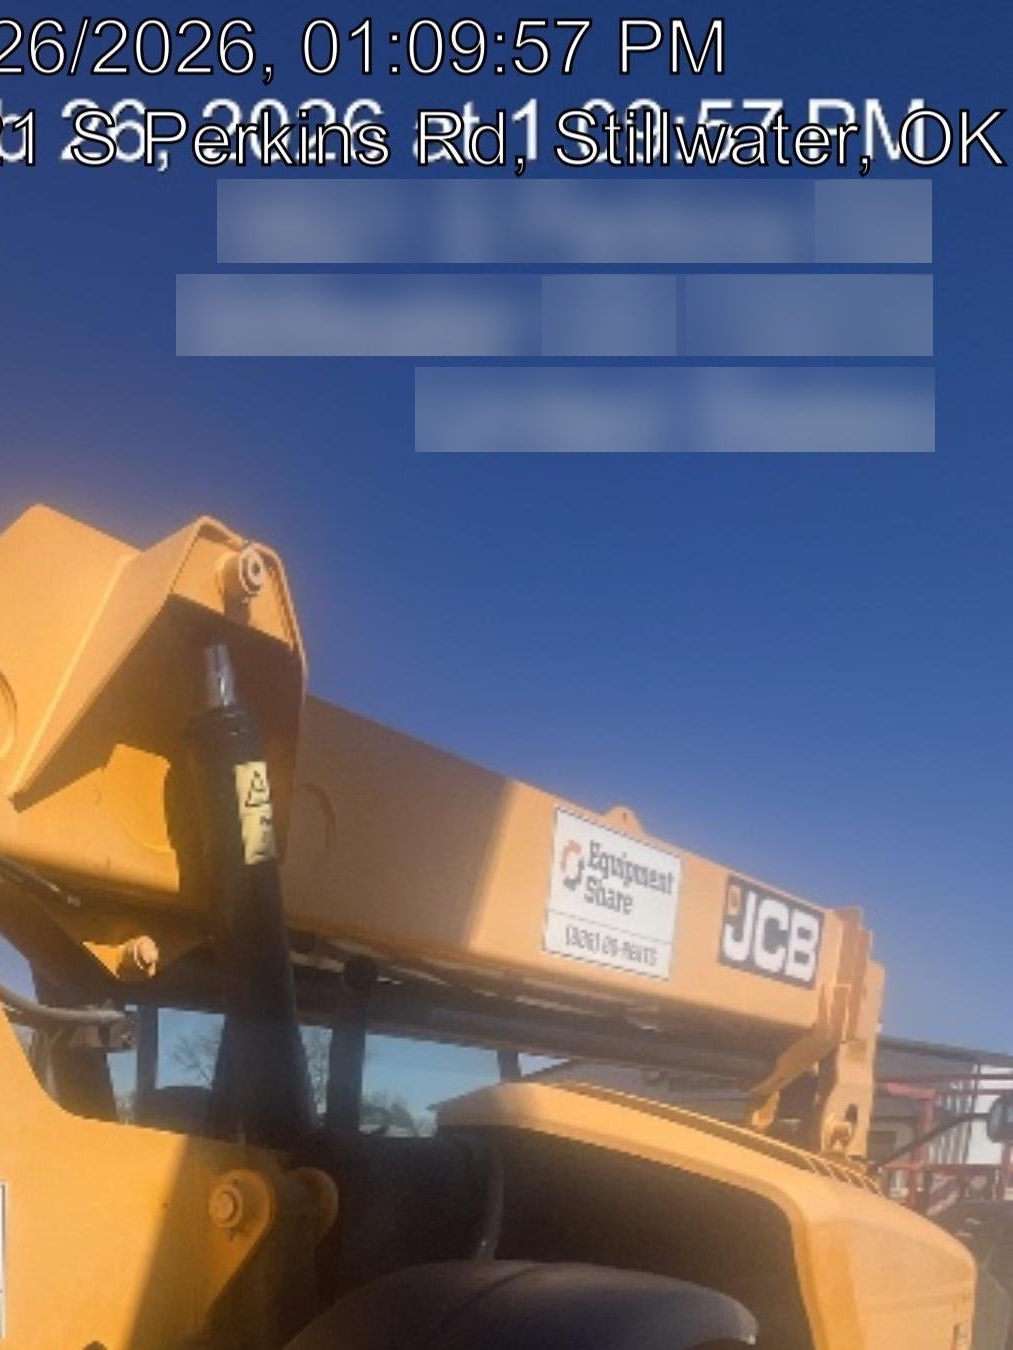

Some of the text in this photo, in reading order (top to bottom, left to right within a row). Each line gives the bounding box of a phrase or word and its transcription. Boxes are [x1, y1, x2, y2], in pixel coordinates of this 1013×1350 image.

[584, 875, 633, 915] Share
[588, 840, 674, 895] Equipment
[723, 889, 820, 982] JCB
